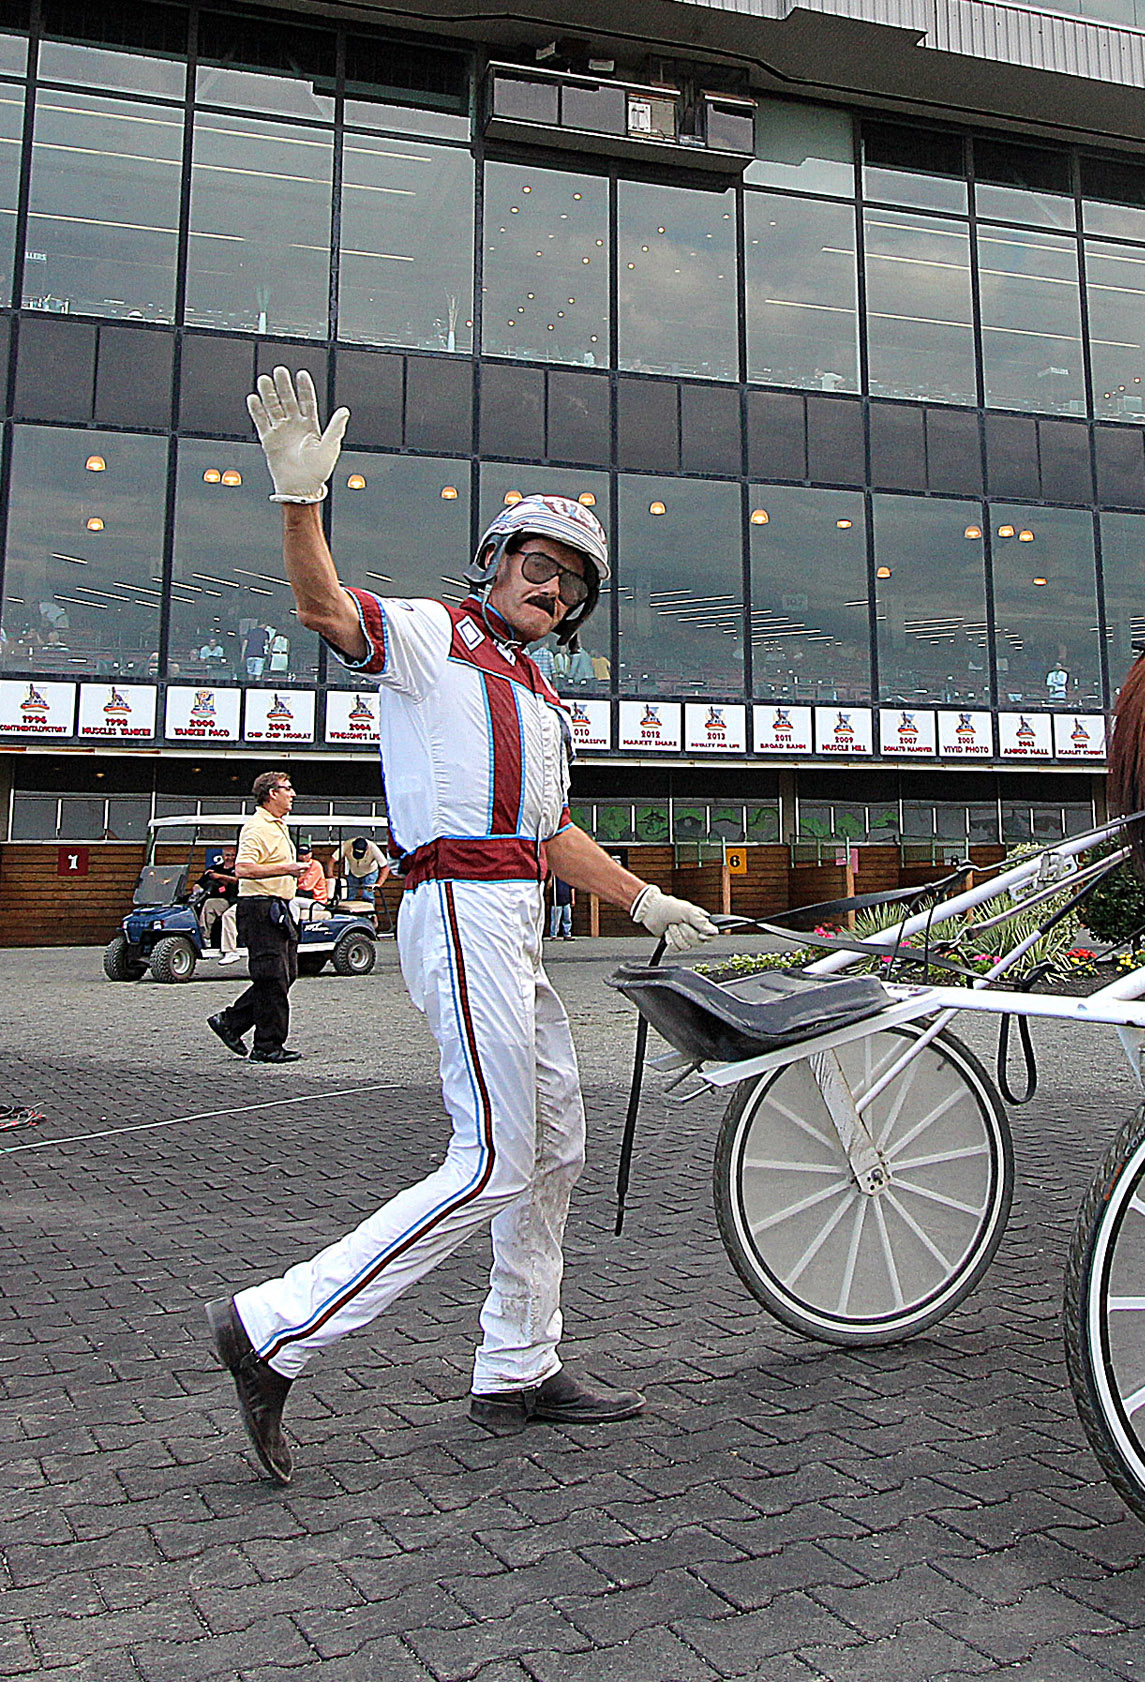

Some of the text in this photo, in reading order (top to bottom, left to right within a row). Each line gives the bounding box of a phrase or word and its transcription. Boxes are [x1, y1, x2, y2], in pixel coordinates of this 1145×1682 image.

[189, 719, 215, 727] 2000
[268, 723, 291, 731] 2002
[82, 727, 116, 735] MUSCLES
[209, 729, 230, 737] PACO
[574, 728, 590, 736] 010
[641, 730, 660, 738] 2012
[707, 732, 726, 740] 2013
[775, 734, 792, 742] 2011
[943, 745, 989, 754] VIVID PHOTO
[68, 854, 79, 870] 1
[729, 855, 740, 867] 6
